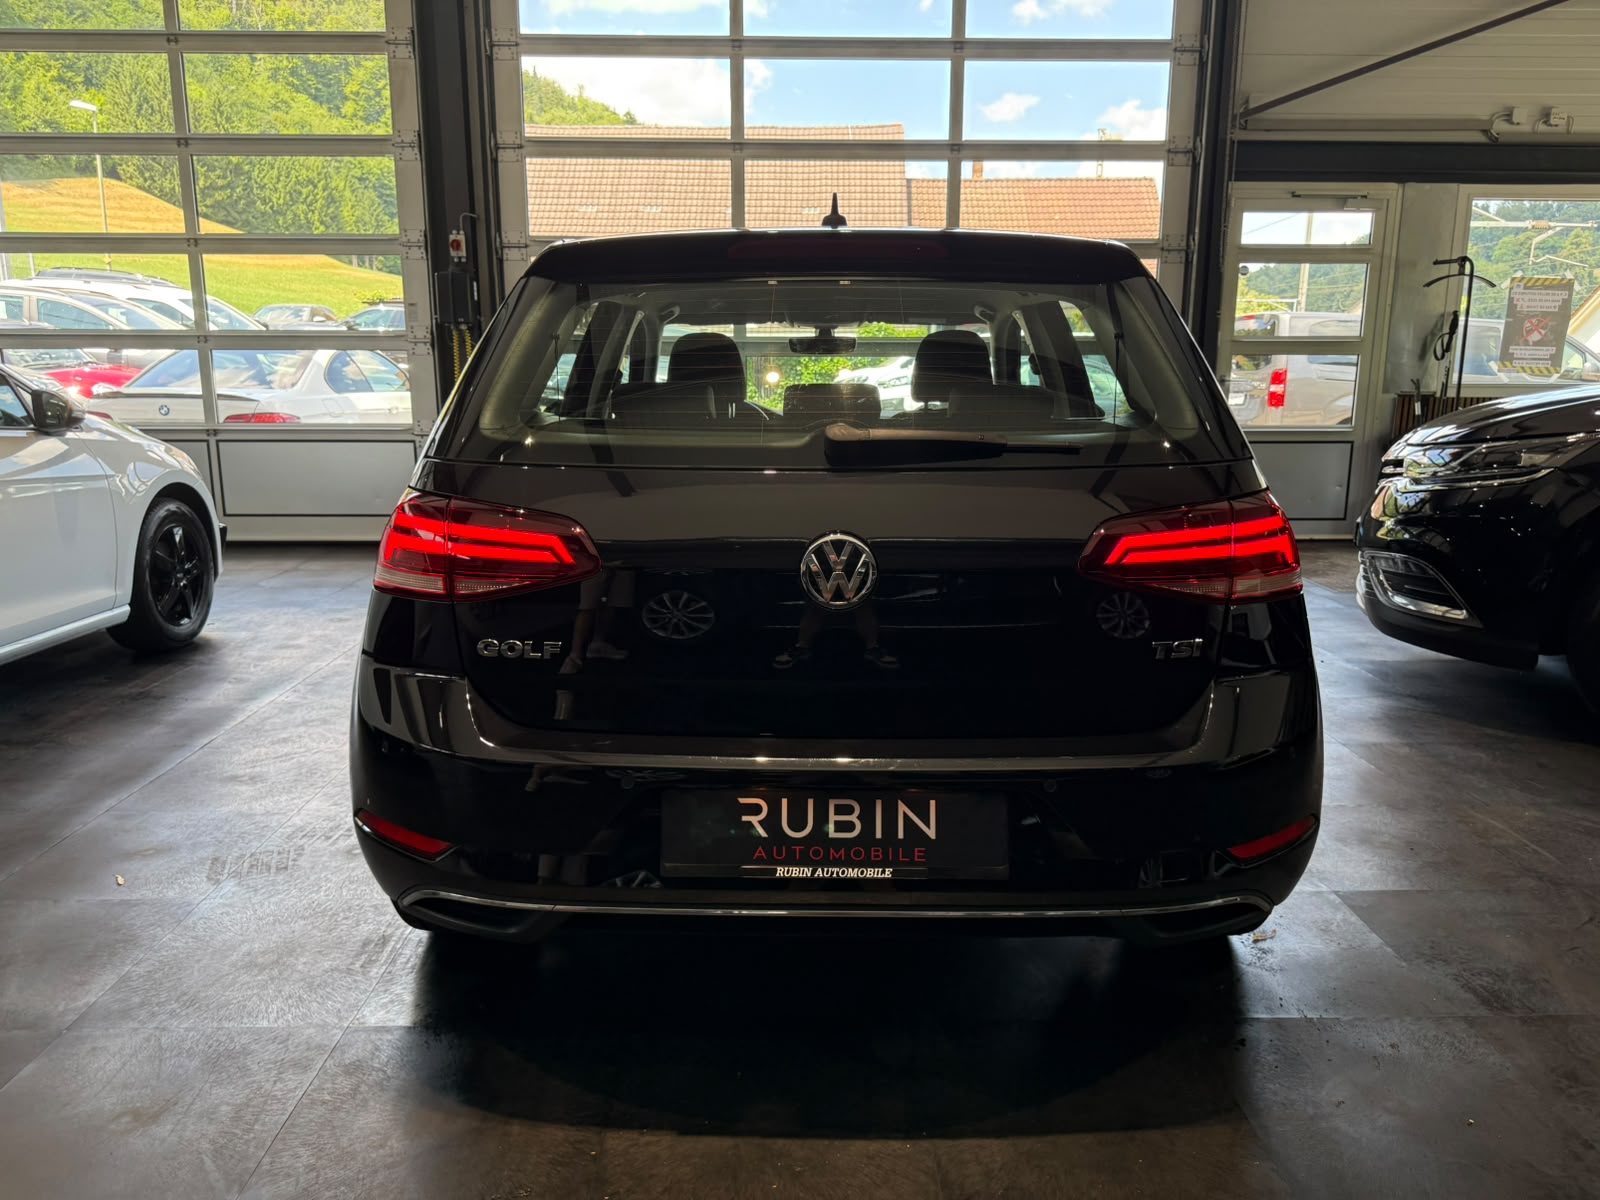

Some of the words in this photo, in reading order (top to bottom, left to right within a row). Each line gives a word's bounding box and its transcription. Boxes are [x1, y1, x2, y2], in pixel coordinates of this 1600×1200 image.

[476, 638, 562, 659] GOLF
[1152, 638, 1203, 659] TSI
[737, 797, 937, 840] RUBIN
[753, 846, 927, 862] AUTOMOBILE
[775, 866, 813, 878] RUBIN
[814, 867, 893, 879] AUTOMOBILE
